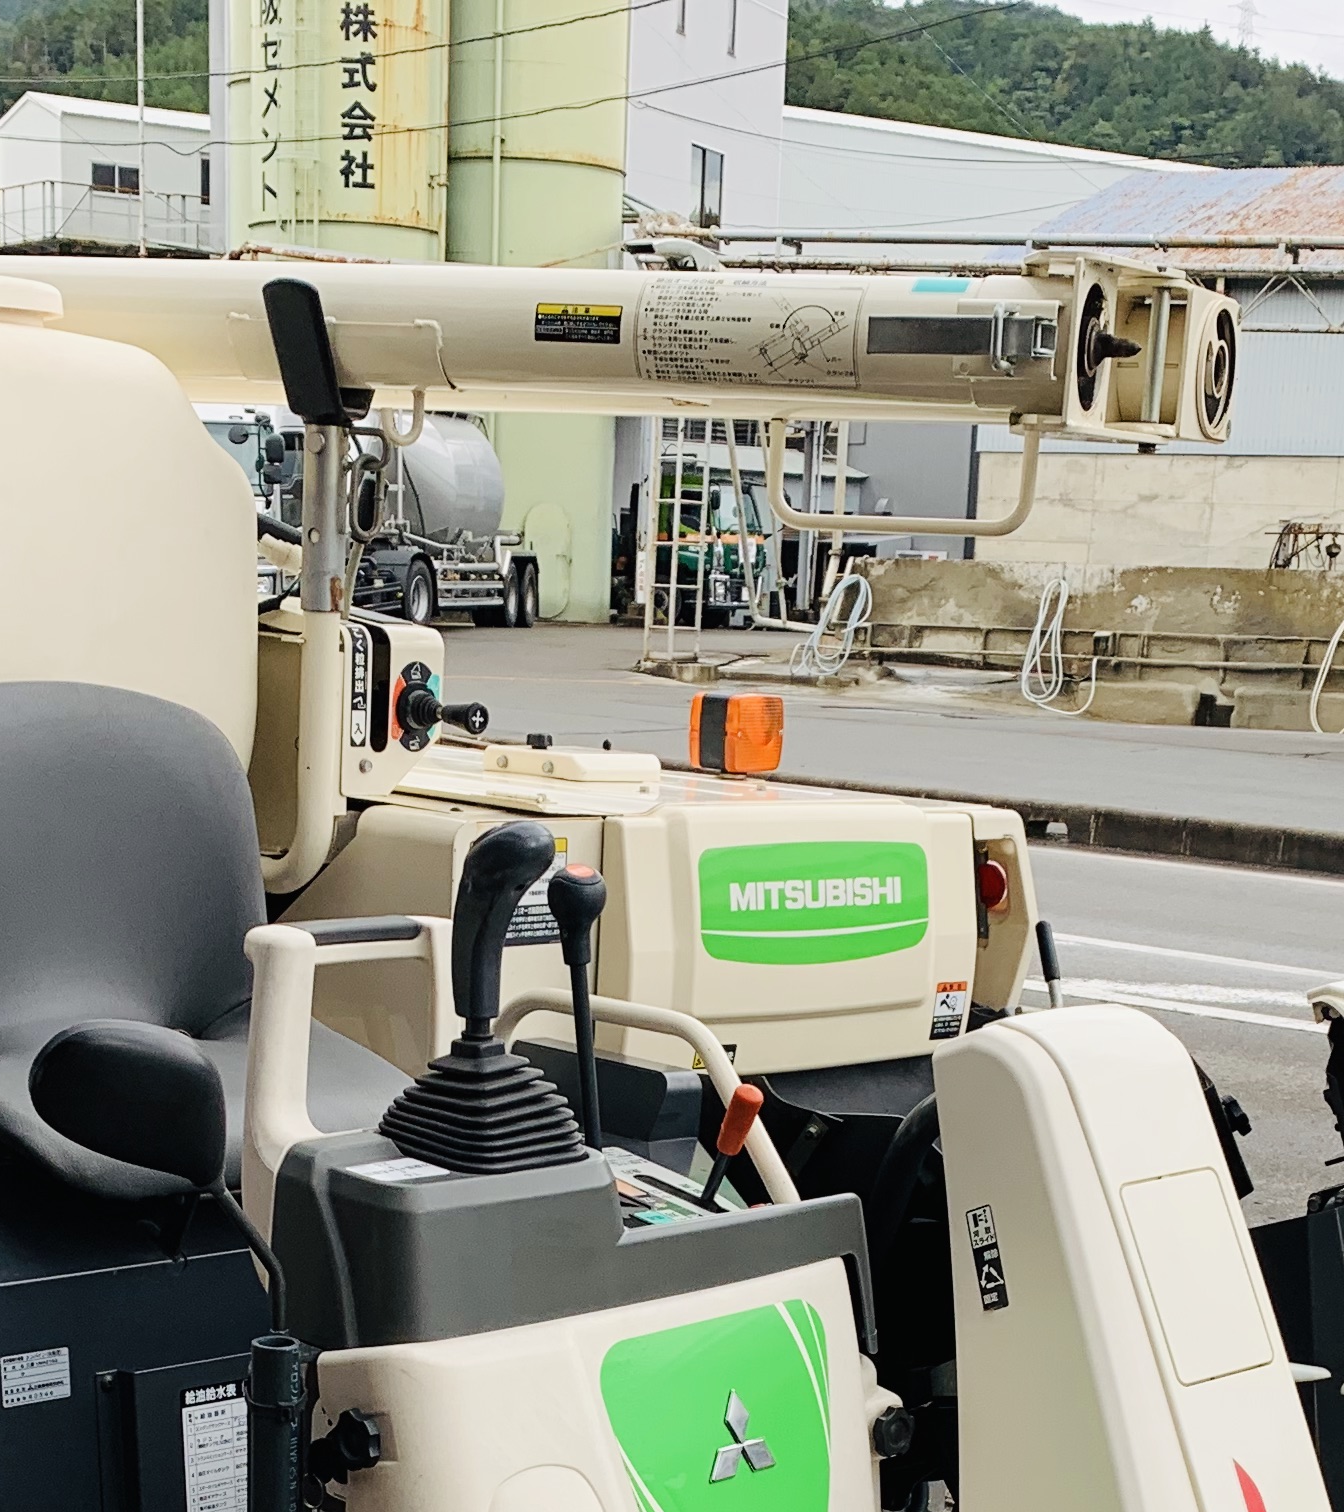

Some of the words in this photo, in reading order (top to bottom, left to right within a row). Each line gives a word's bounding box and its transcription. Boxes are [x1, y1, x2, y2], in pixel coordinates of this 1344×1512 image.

[340, 2, 377, 189] 株式会社
[729, 876, 902, 912] MITSUBISHI
[185, 1383, 237, 1405] 給油給水表
